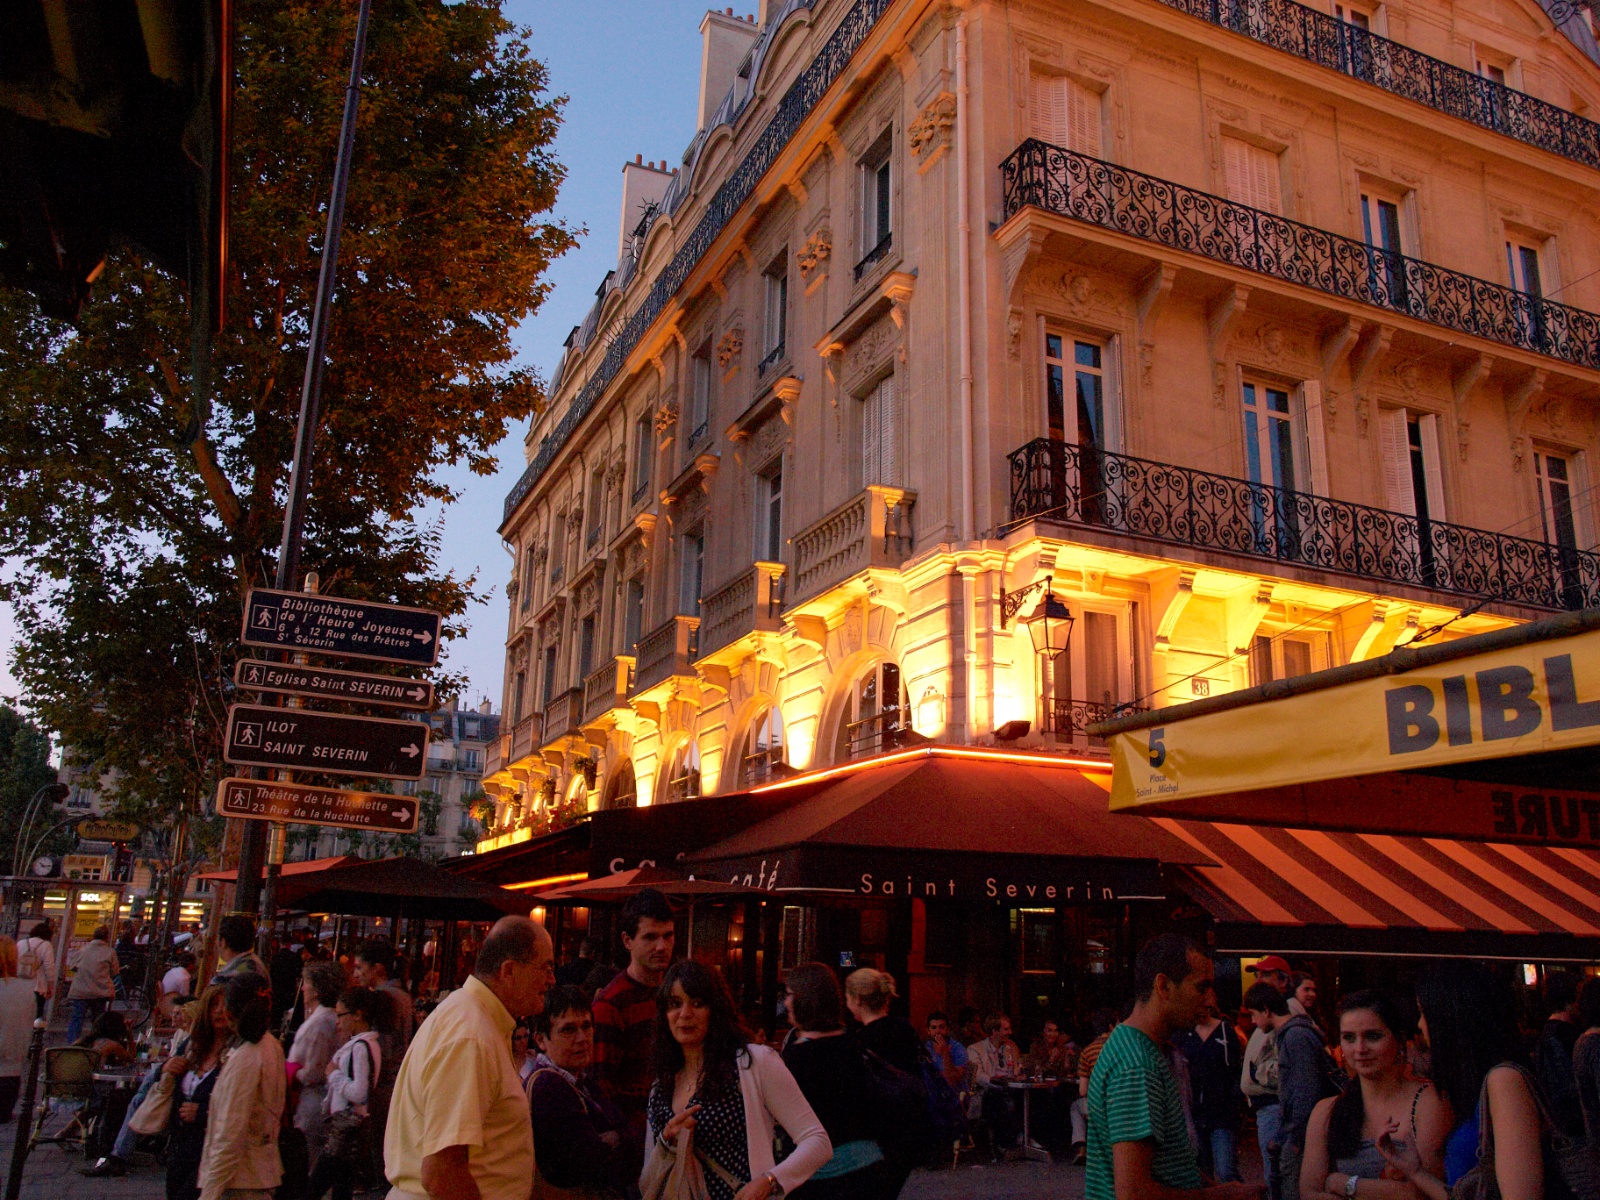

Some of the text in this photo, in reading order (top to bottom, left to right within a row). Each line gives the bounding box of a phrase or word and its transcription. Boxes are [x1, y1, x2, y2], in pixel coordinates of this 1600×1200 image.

[281, 598, 364, 619] Bibliothèque
[280, 611, 296, 621] de
[317, 617, 355, 629] Heure
[362, 621, 413, 637] Joyeuse
[278, 623, 410, 648] 6 à 12 Rue des Prêtres
[295, 635, 335, 648] Séverin
[267, 671, 405, 698] Eglise Saint SEVERIN
[1195, 681, 1208, 696] 38
[1385, 653, 1600, 755] BIBL
[266, 720, 298, 734] ILOT
[263, 741, 369, 762] SAINT SEVERIN
[1149, 727, 1166, 768] 5
[1149, 773, 1167, 783] Place
[256, 786, 300, 802] Théâtre
[303, 793, 318, 804] de
[321, 795, 333, 806] la
[1136, 786, 1153, 797] Saint
[1158, 783, 1179, 794] Michel
[269, 804, 290, 816] Rue
[293, 807, 306, 818] de
[310, 808, 320, 819] la
[324, 811, 371, 824] Huchette
[860, 873, 1113, 900] Saint Severin
